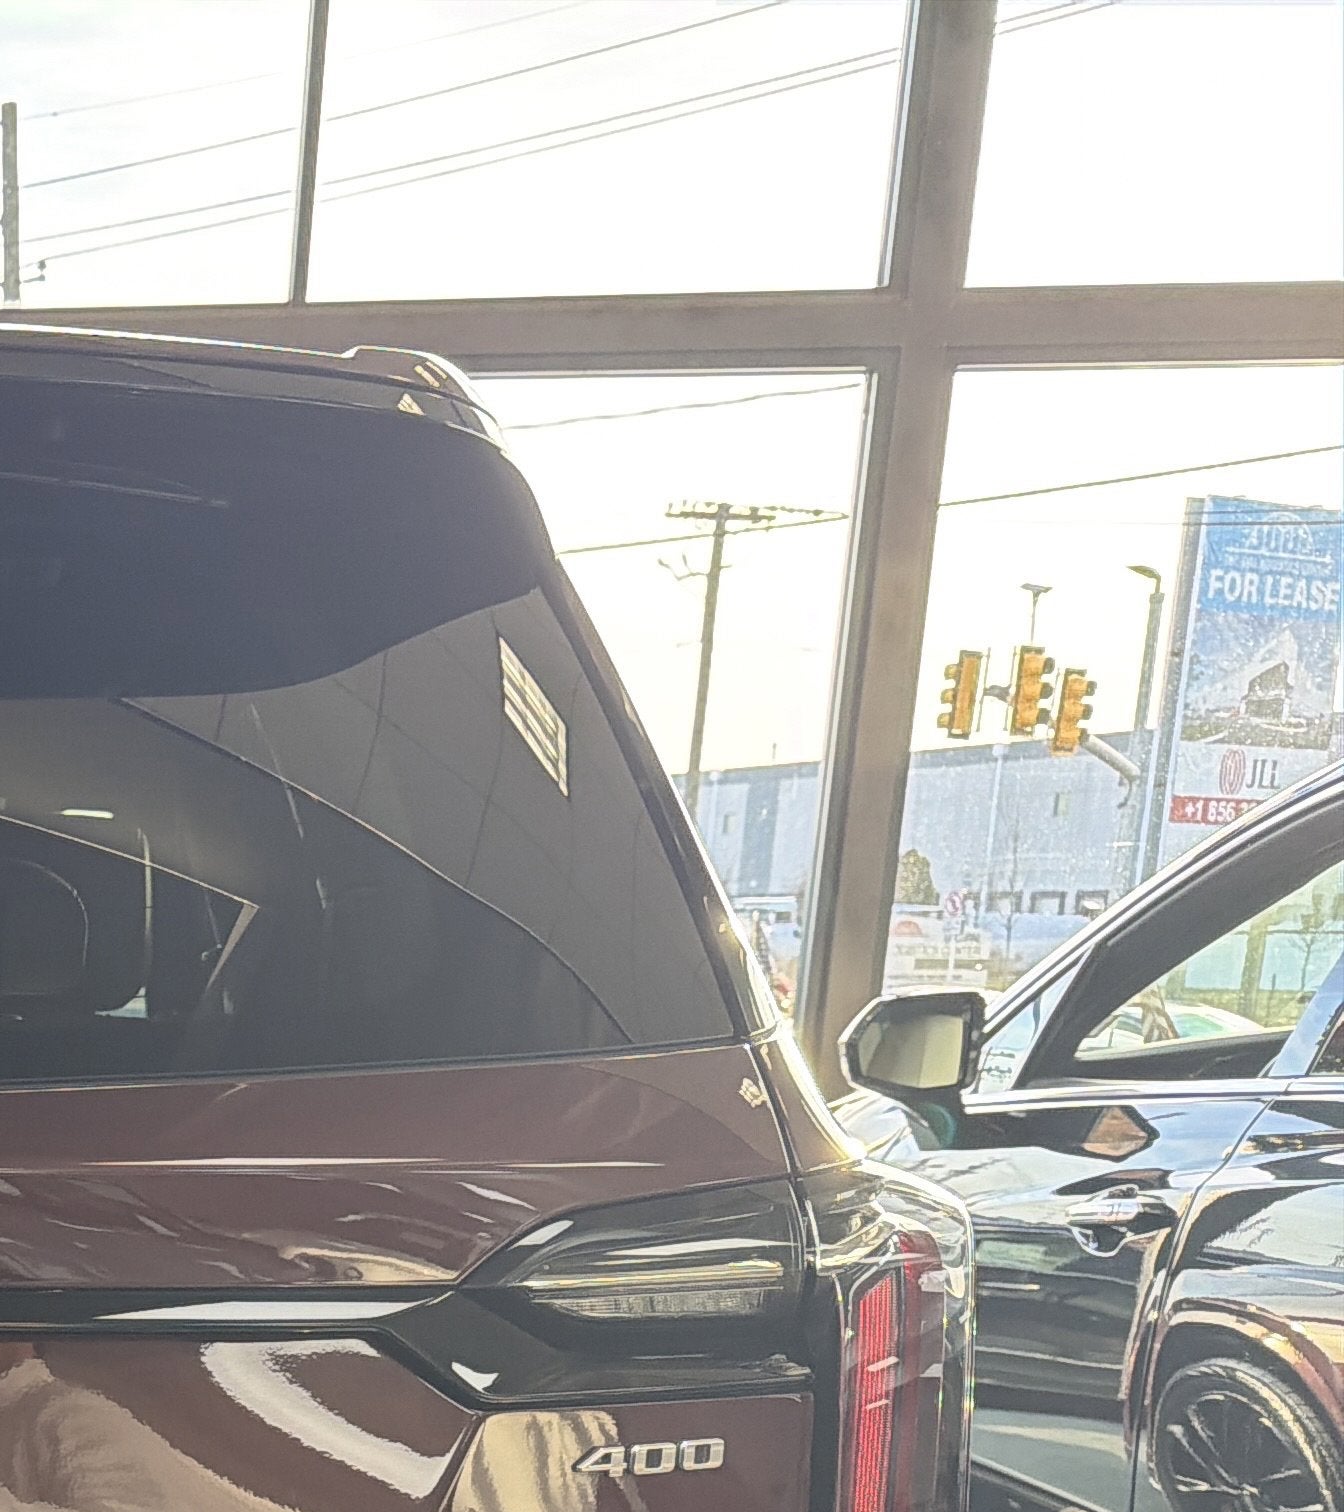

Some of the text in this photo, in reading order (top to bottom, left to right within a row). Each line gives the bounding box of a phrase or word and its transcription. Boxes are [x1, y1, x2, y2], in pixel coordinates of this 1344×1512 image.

[1208, 568, 1340, 611] FOR LEASE
[1245, 759, 1280, 789] JLL
[571, 1437, 725, 1477] 400
